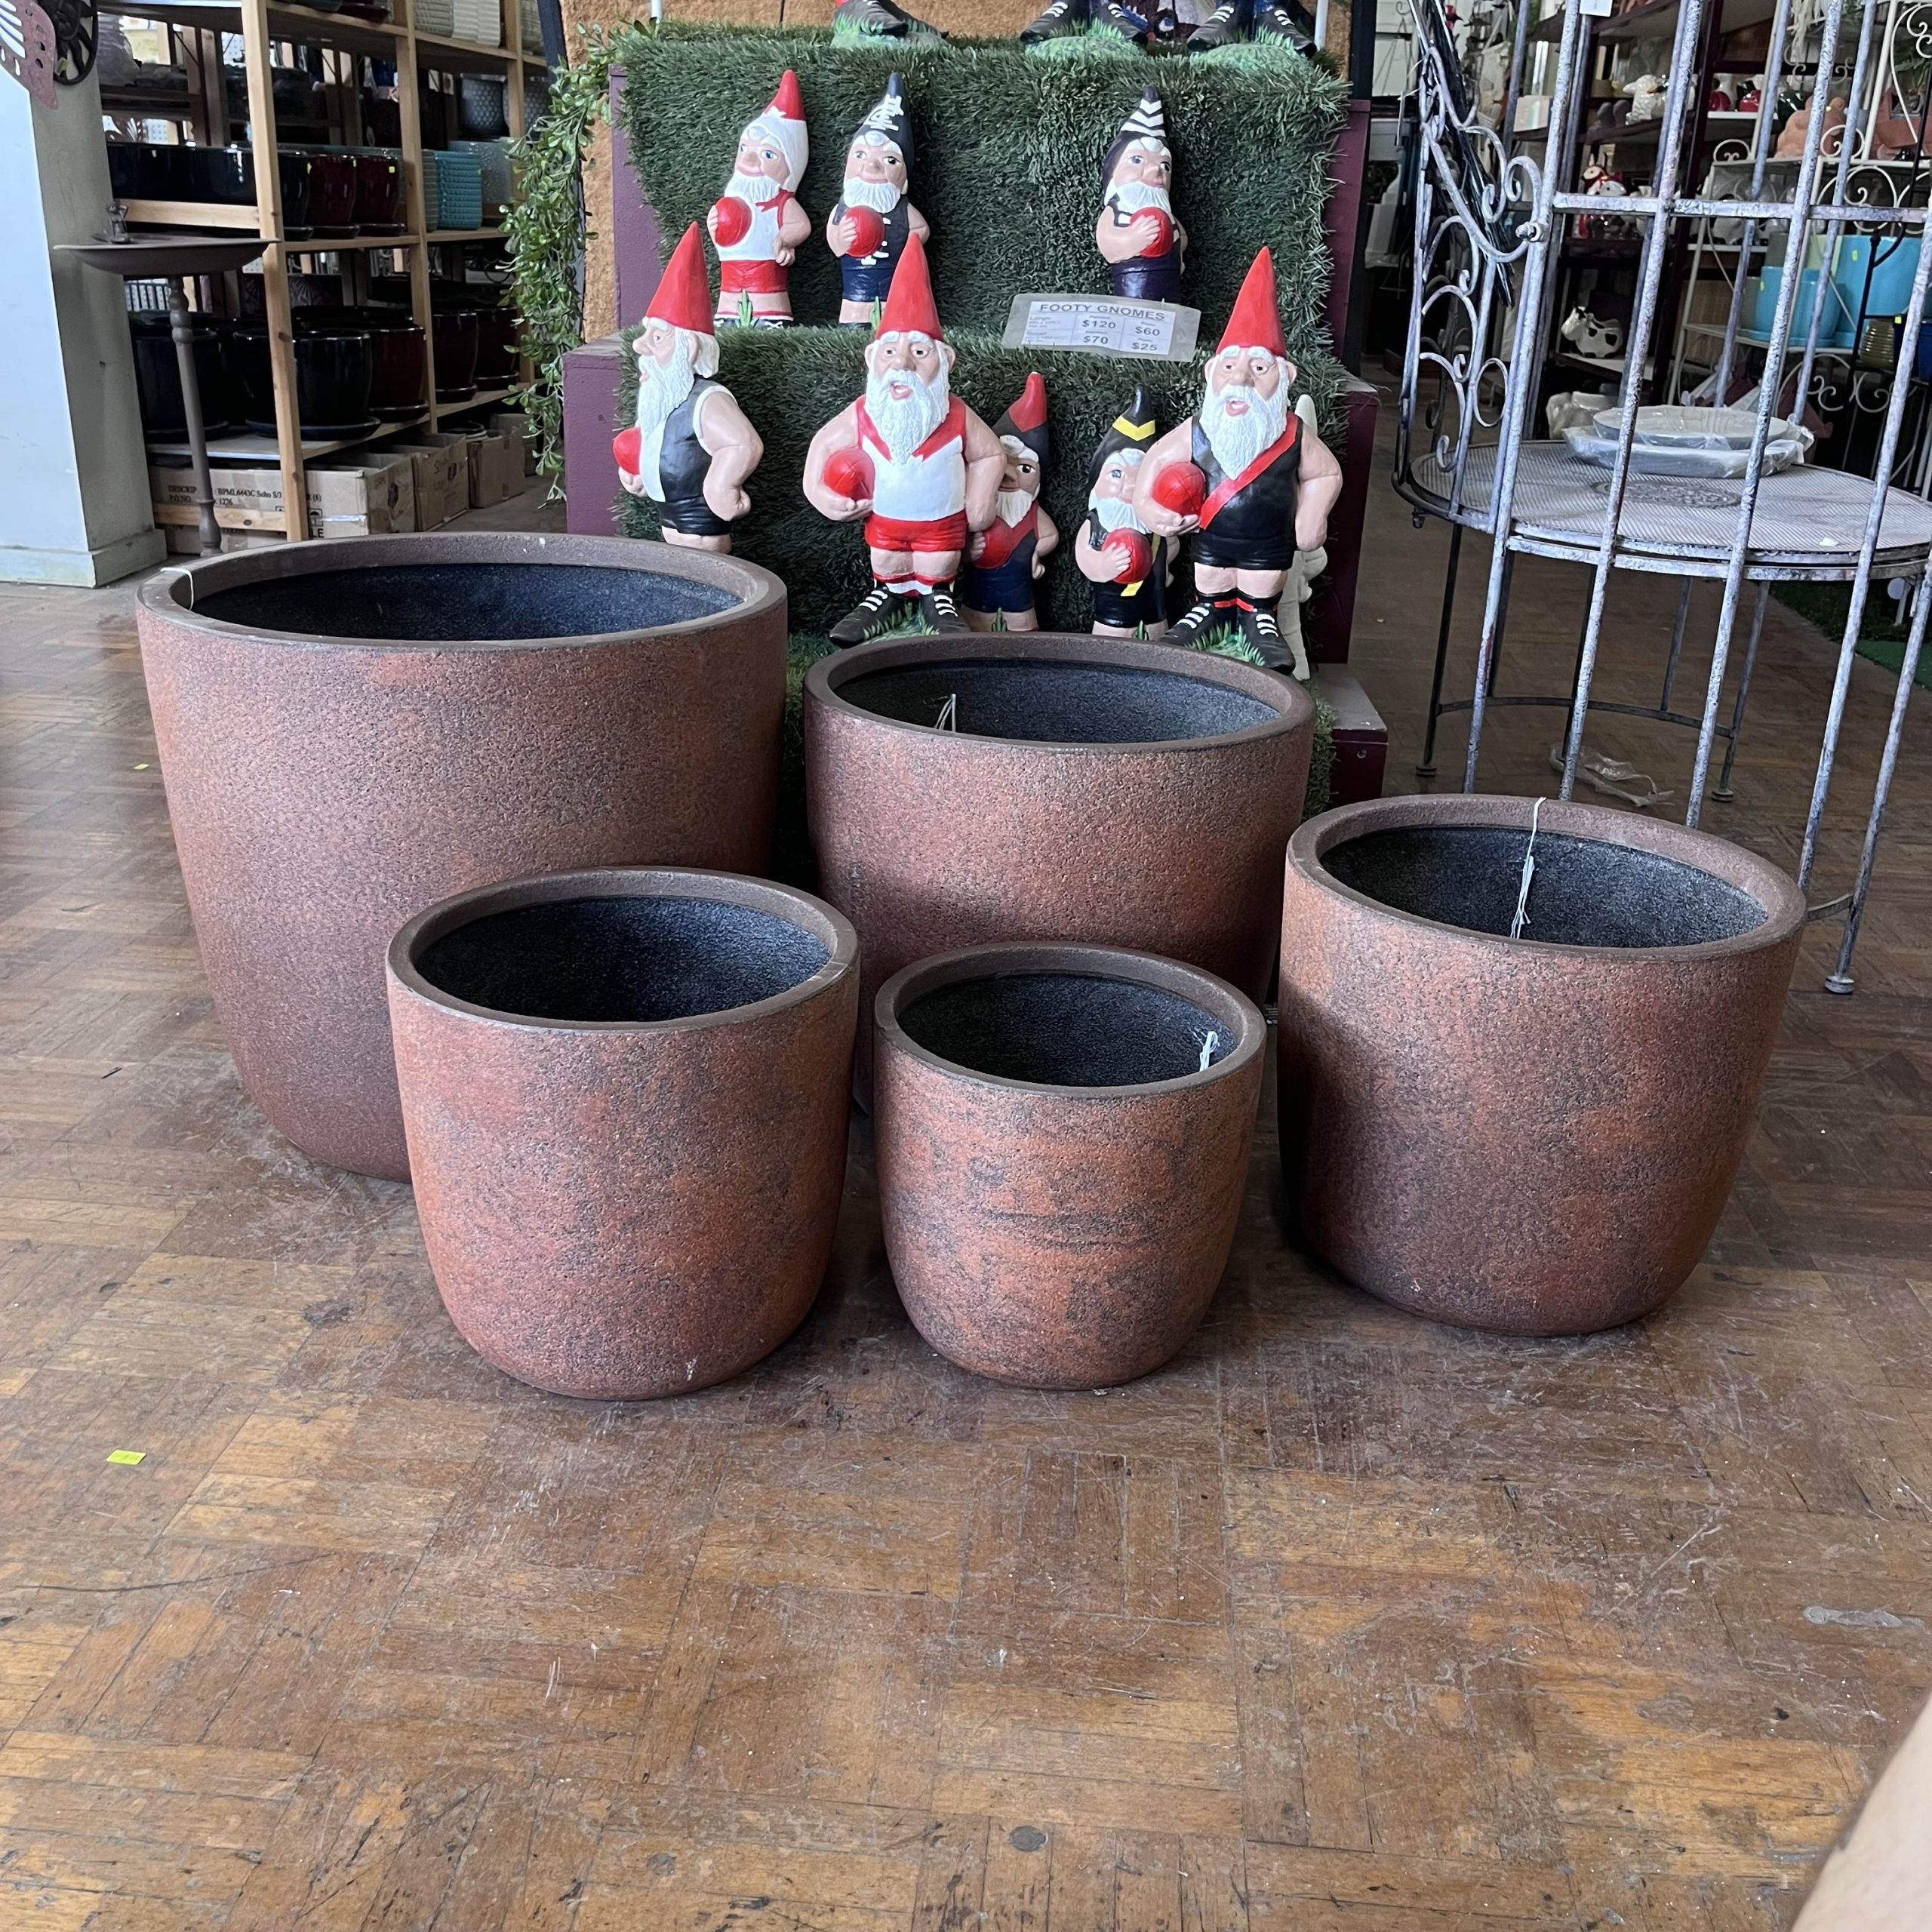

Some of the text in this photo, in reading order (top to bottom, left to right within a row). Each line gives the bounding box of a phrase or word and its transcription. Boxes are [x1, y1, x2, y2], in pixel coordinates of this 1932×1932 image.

[1039, 303, 1093, 312] FOOTY
[1097, 304, 1165, 321] GNOMES
[1081, 319, 1116, 329] $120
[1134, 325, 1160, 337] $60
[1082, 335, 1109, 345] $70
[1131, 342, 1158, 351] $25
